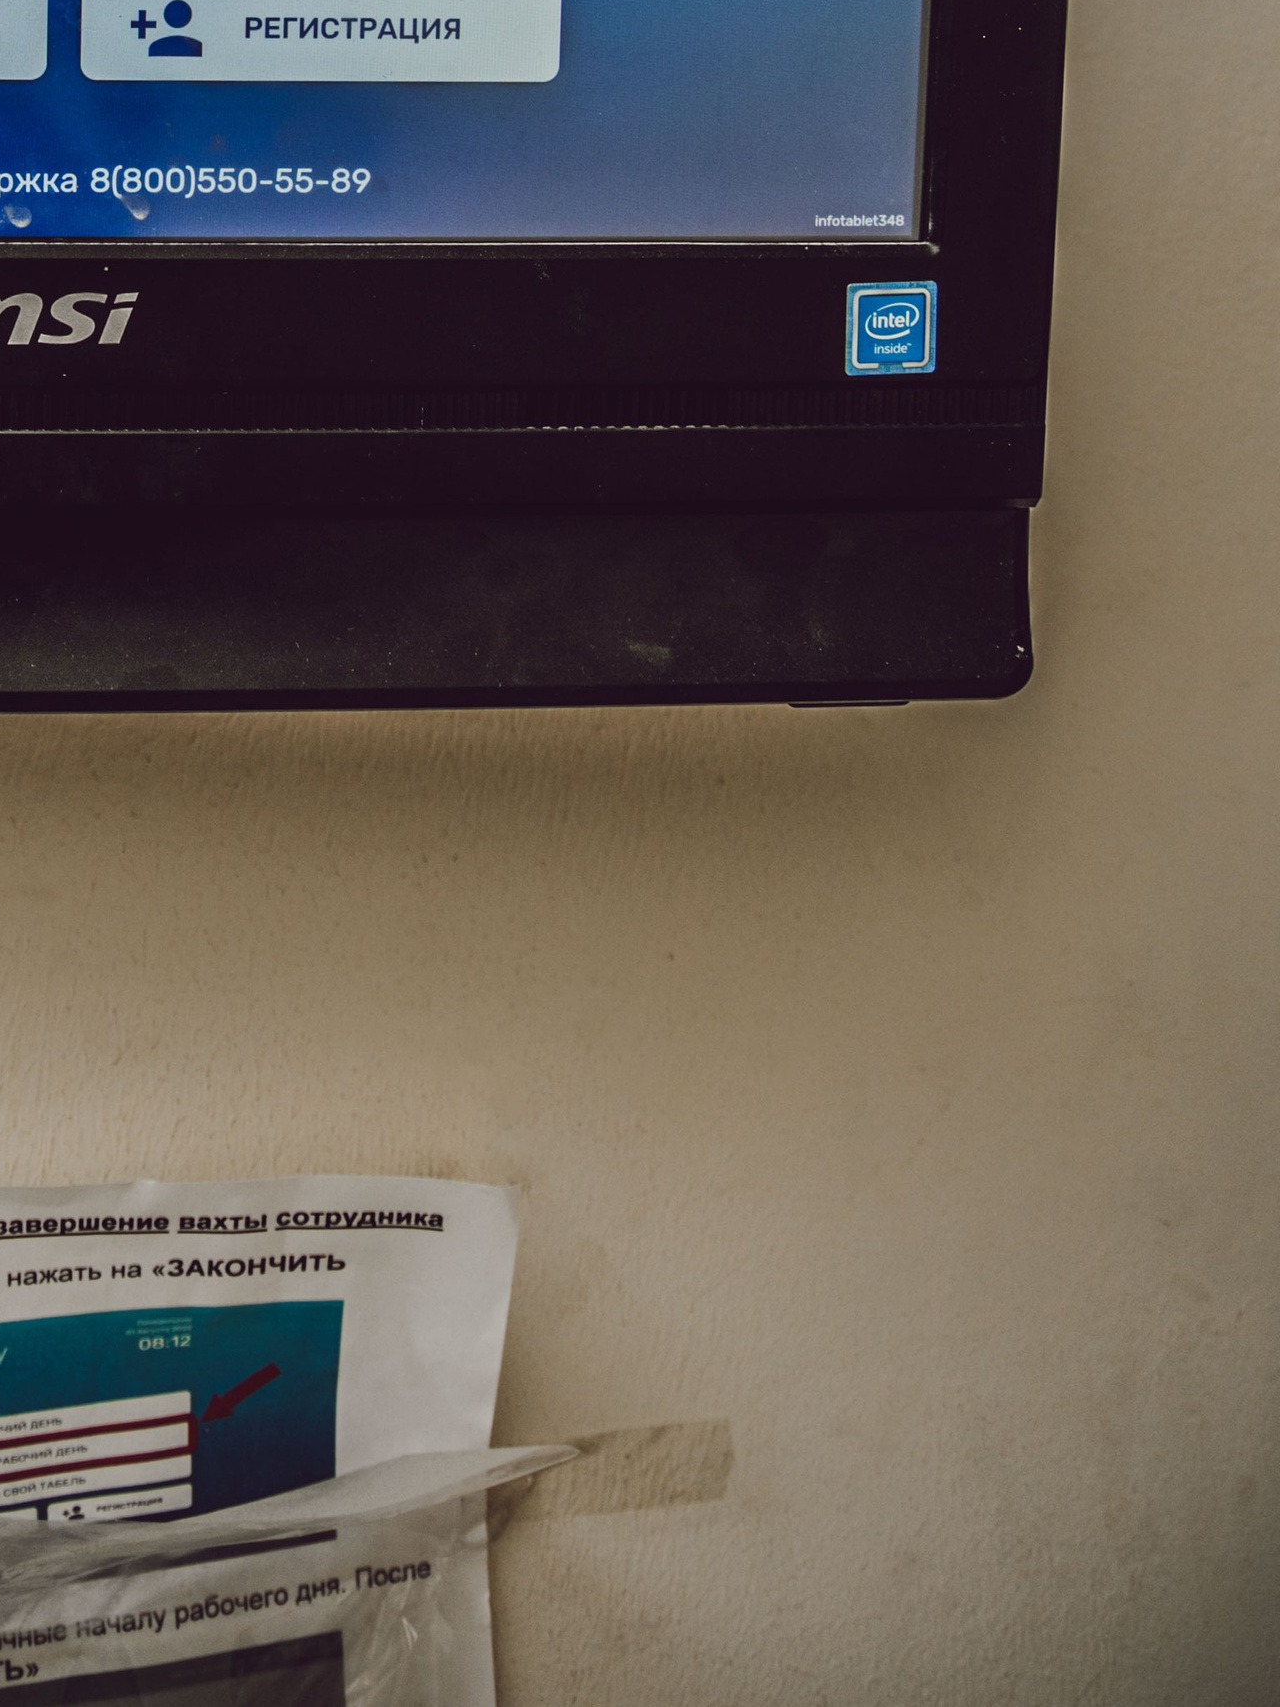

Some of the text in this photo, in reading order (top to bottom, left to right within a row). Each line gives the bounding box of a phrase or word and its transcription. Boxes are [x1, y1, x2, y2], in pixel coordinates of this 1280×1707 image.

[244, 16, 462, 45] РЕГИСТРАЦИЯ
[89, 166, 372, 200] 8(800)550-55-89
[815, 214, 905, 228] infotablet348
[872, 310, 912, 329] intel
[178, 1212, 268, 1234] вахты
[275, 1208, 445, 1232] сотрудника
[7, 1265, 102, 1287] нажать
[112, 1262, 142, 1279] на
[153, 1253, 346, 1279] «ЗАКОНЧИТЬ
[138, 1335, 191, 1351] 08:12
[30, 1417, 63, 1430] ДЕНЬ
[55, 1444, 89, 1457] ДЕНЬ
[2, 1482, 38, 1499] СВОЙ
[40, 1476, 87, 1493] ТАБЕЛЬ
[75, 1606, 167, 1640] началу
[174, 1589, 290, 1630] рабочего
[295, 1574, 347, 1607] дня.
[354, 1558, 432, 1593] После
